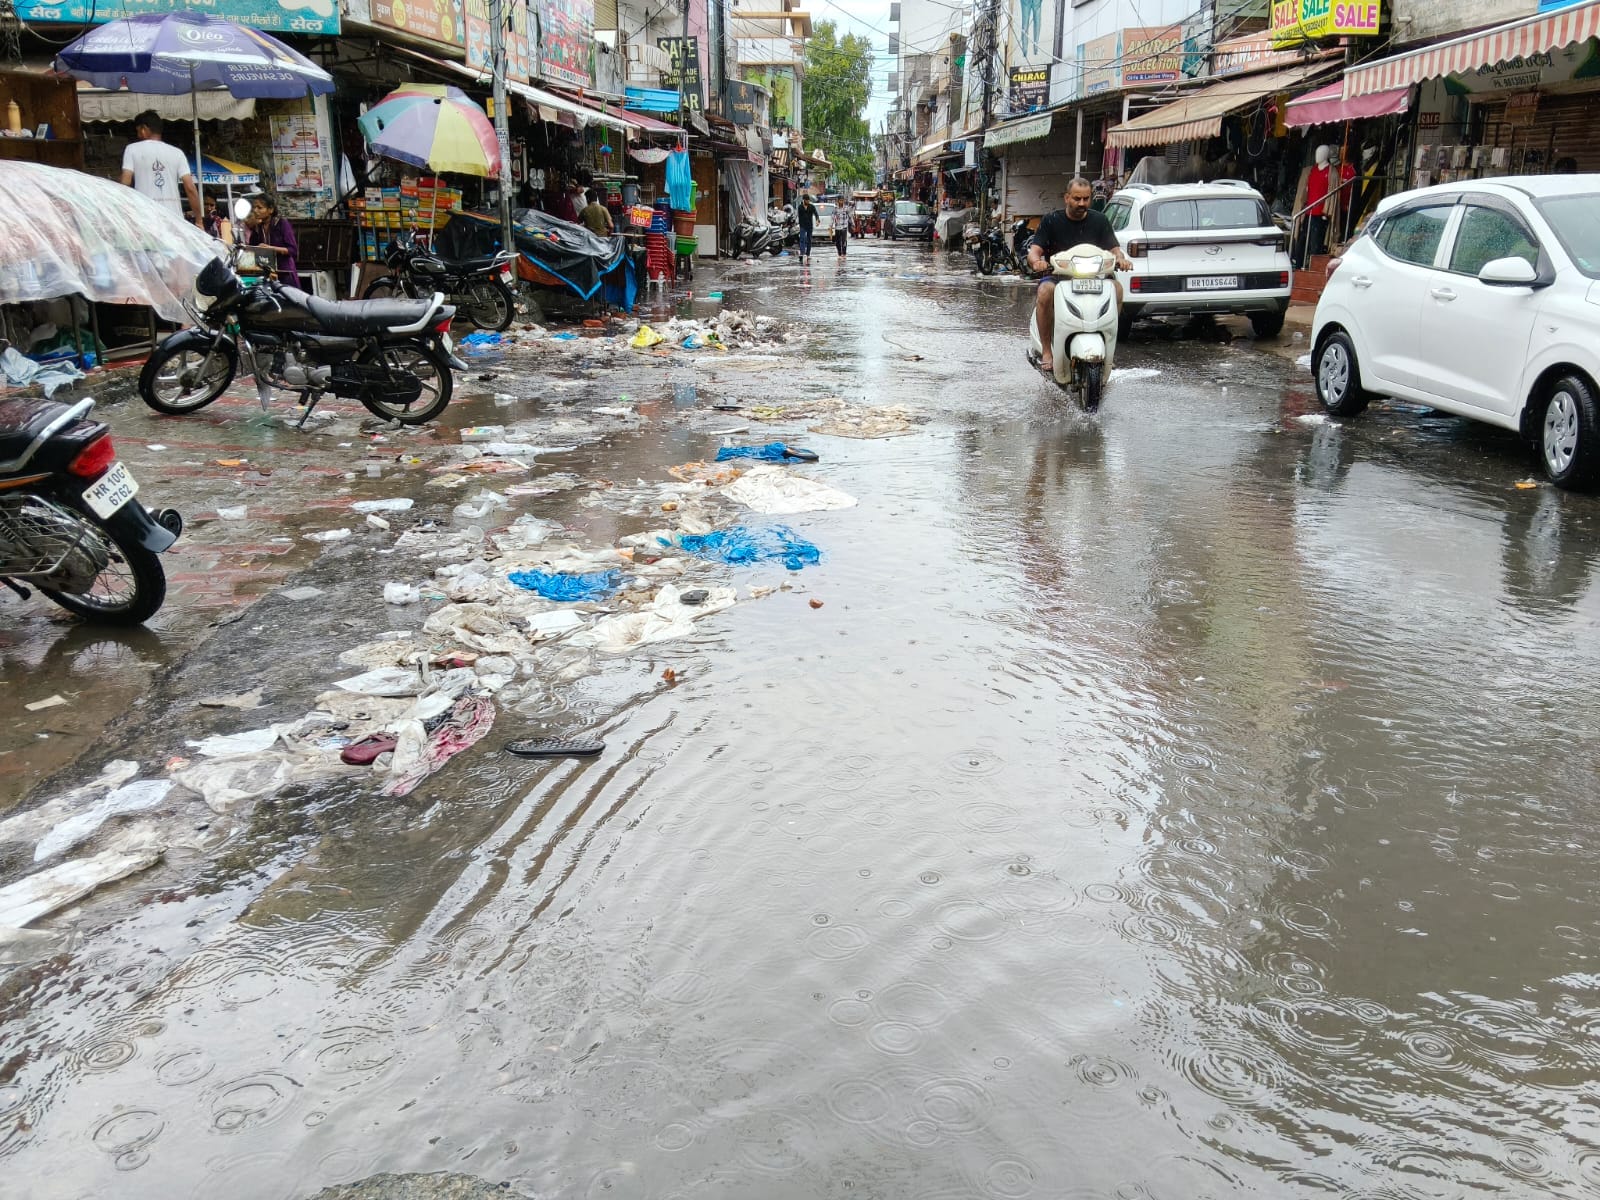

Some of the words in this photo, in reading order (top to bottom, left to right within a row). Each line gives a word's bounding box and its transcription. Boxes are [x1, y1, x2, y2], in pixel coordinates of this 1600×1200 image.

[1274, 2, 1298, 30] SALE
[1302, 0, 1329, 20] SALE
[1335, 4, 1376, 28] SALE
[290, 15, 324, 31] सेल
[1126, 57, 1179, 72] COLLECTION
[1012, 71, 1047, 82] CHIRAG
[92, 483, 110, 500] HR
[108, 484, 132, 506] 6762
